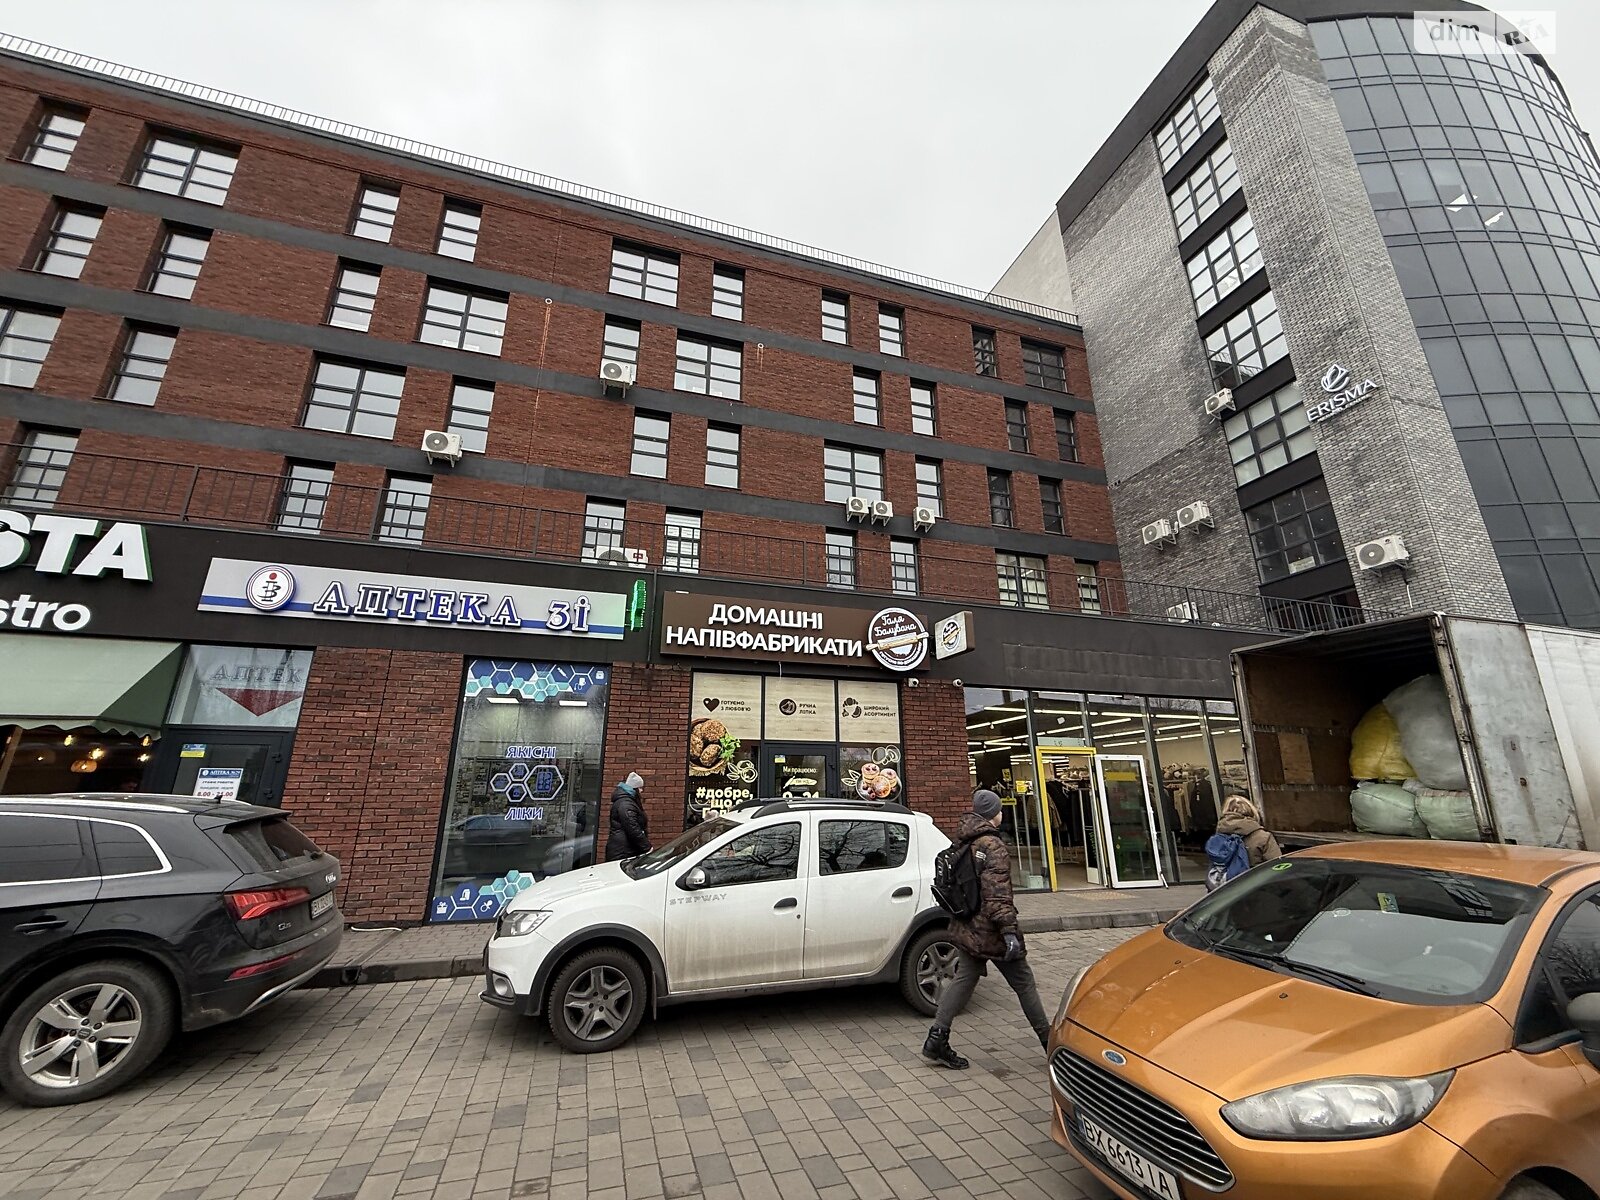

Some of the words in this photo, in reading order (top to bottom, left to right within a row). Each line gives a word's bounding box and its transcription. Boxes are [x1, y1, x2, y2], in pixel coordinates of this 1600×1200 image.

[1307, 379, 1377, 422] ERISMA
[313, 580, 522, 627] АПТЕКА
[708, 602, 823, 630] ДОМАШНІ
[881, 614, 905, 626] Галя
[874, 622, 917, 636] Балувана
[665, 626, 863, 658] НАПІВФАБРИКАТИ
[506, 746, 557, 759] ЯКІСНІ
[696, 787, 754, 800] #добре,
[504, 806, 544, 820] ЛІКИ
[669, 893, 728, 906] STEPWAY
[1084, 1120, 1106, 1151] BX
[1107, 1137, 1144, 1179] 6613
[1148, 1163, 1173, 1199] IA
